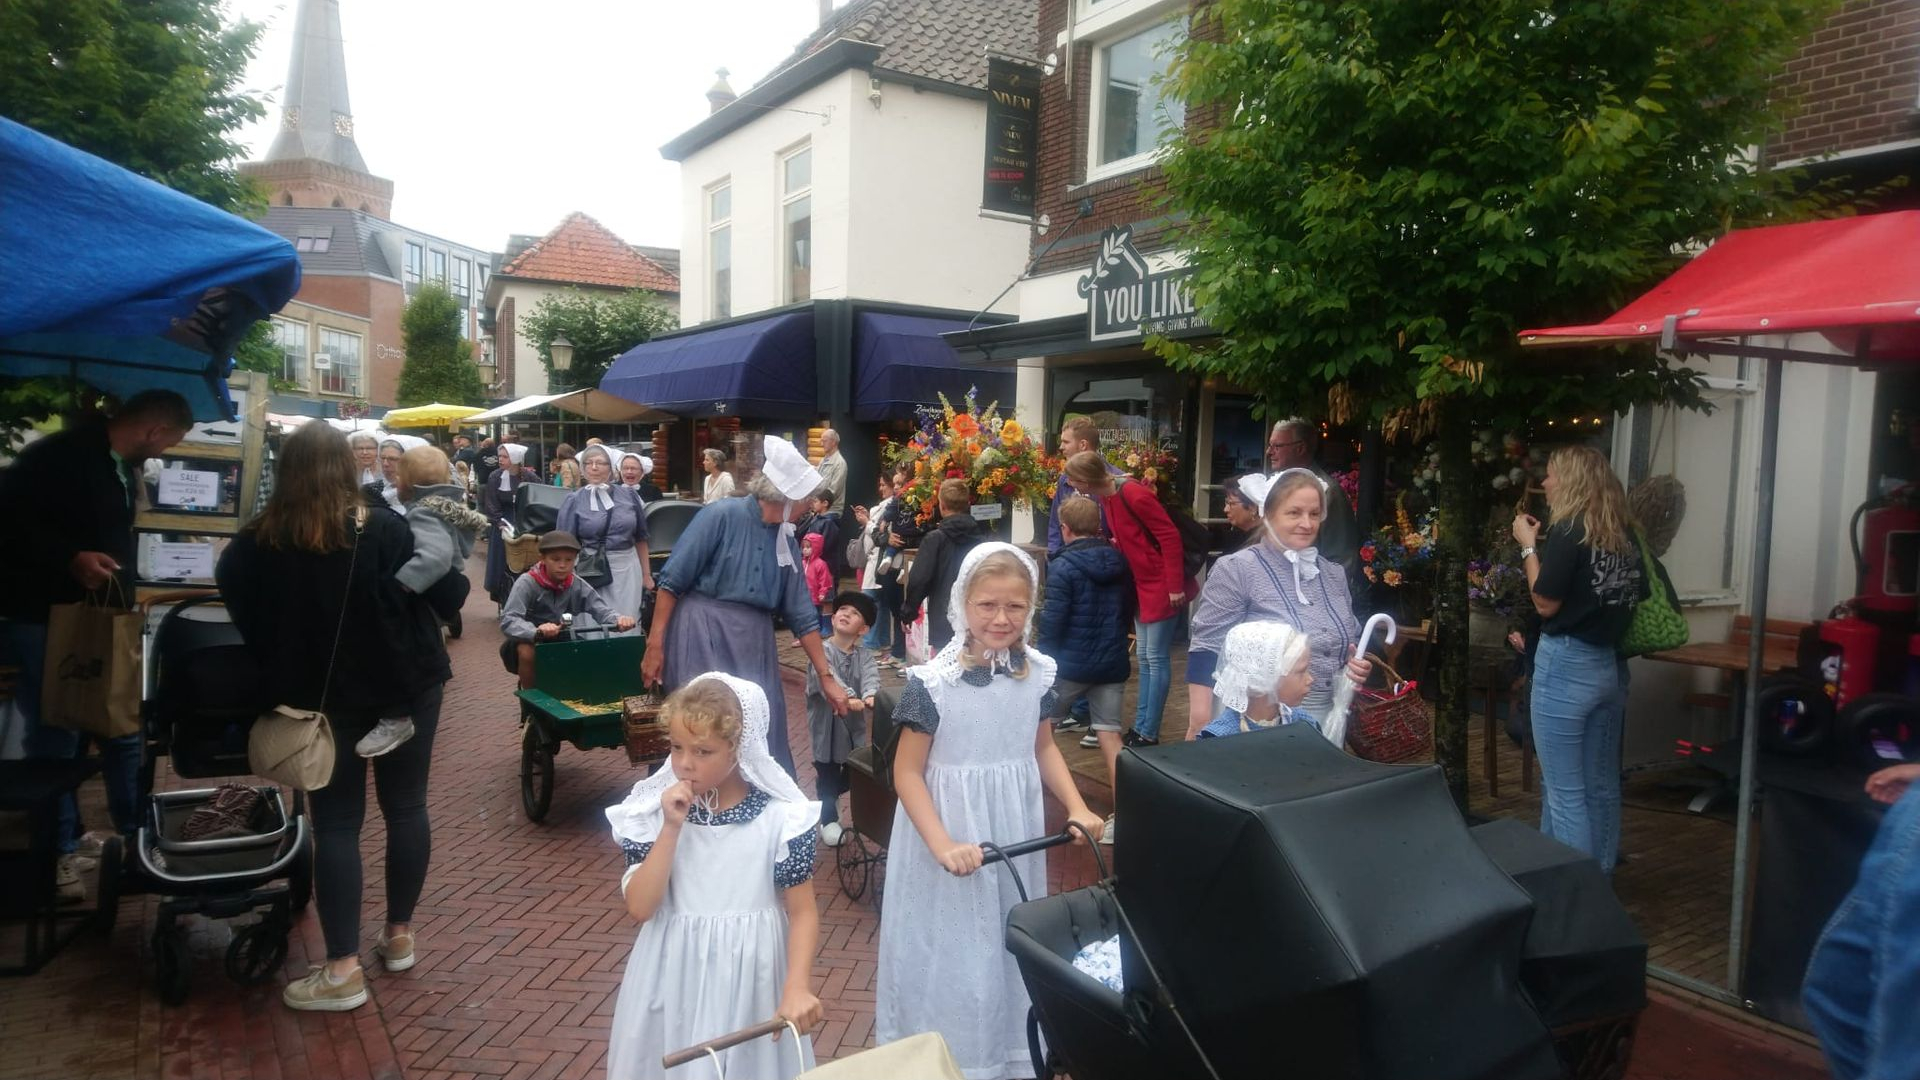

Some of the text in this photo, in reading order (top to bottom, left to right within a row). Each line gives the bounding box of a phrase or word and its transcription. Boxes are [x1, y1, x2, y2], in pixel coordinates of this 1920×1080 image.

[1103, 283, 1143, 325] YOU
[1167, 317, 1188, 332] GIVING
[180, 472, 199, 483] SALE
